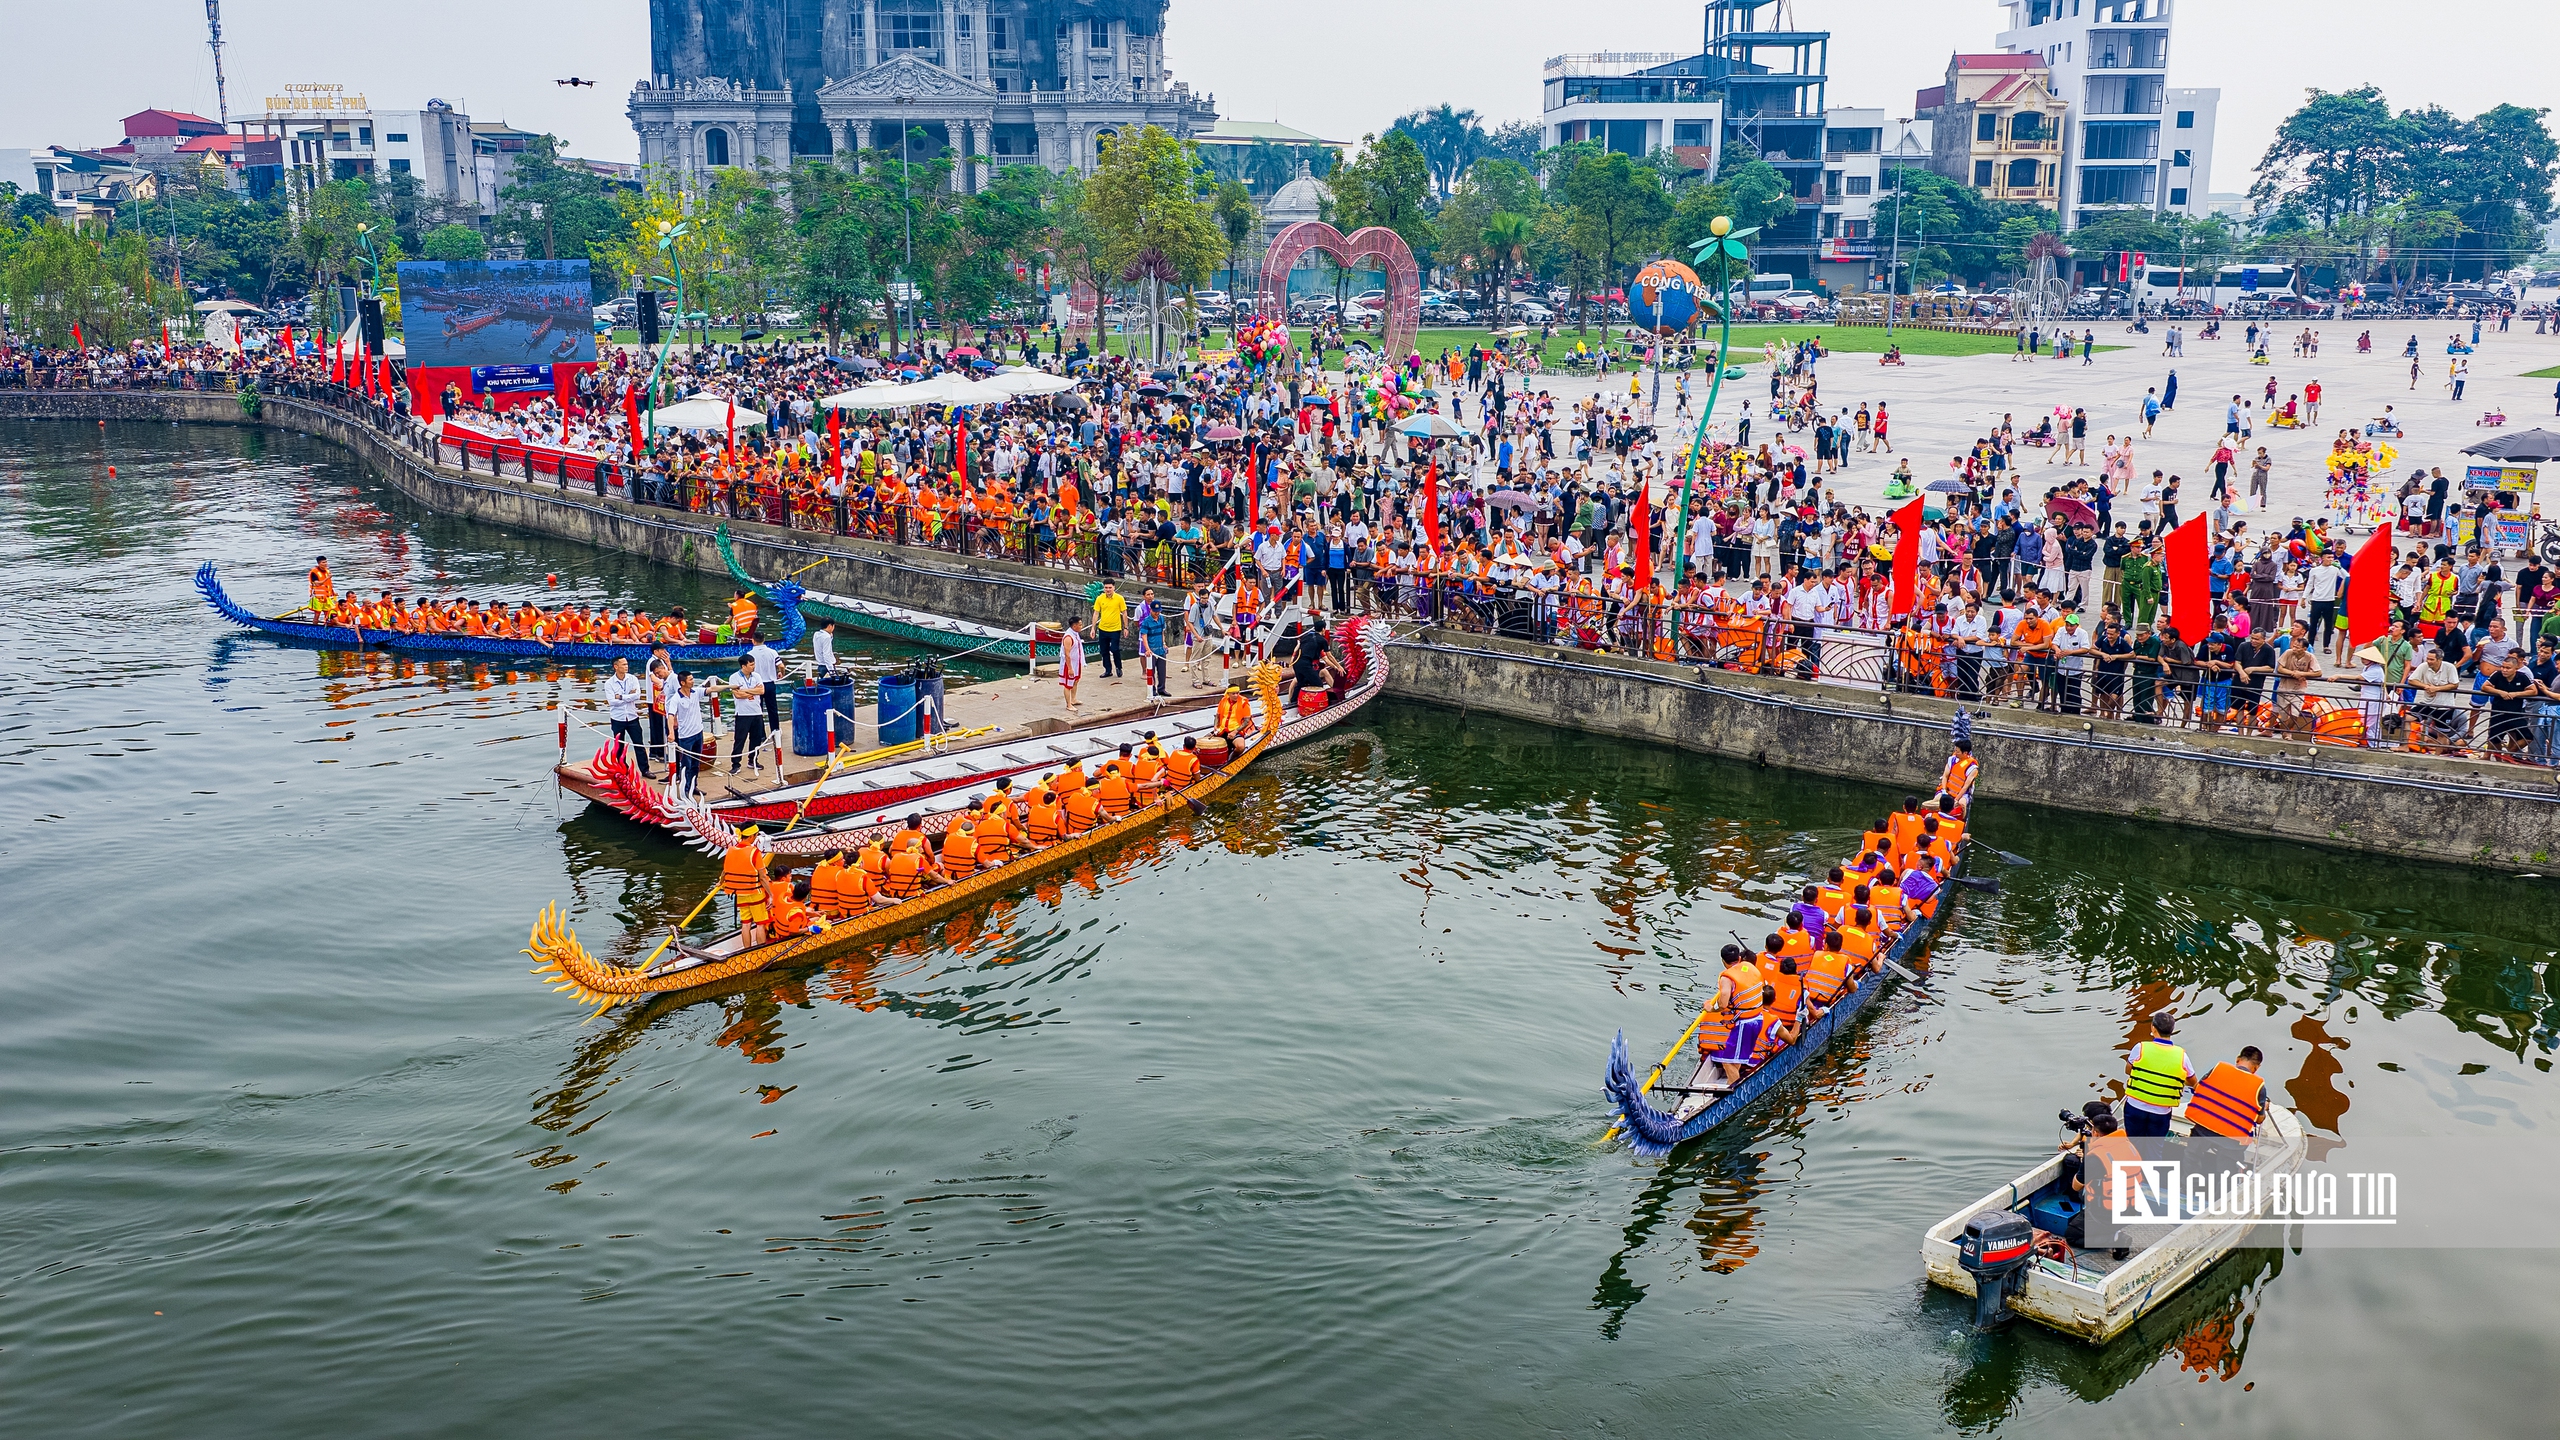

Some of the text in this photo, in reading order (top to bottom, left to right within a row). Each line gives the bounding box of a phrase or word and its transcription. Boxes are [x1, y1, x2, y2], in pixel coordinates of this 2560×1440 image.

[1592, 49, 1620, 63] CHÉRIE
[1623, 52, 1653, 63] COFFEE
[1660, 52, 1675, 63] TEA
[295, 82, 335, 92] QUỲNH
[265, 94, 290, 109] BÚN
[293, 93, 309, 109] BÒ
[311, 92, 335, 109] HUẾ
[342, 92, 366, 109] PHỞ
[1641, 272, 1681, 290] CÔNG
[500, 379, 513, 387] VỰC
[521, 377, 540, 386] THUẬT
[1963, 1242, 1975, 1253] 40
[1987, 1238, 2017, 1251] YAMAHA
